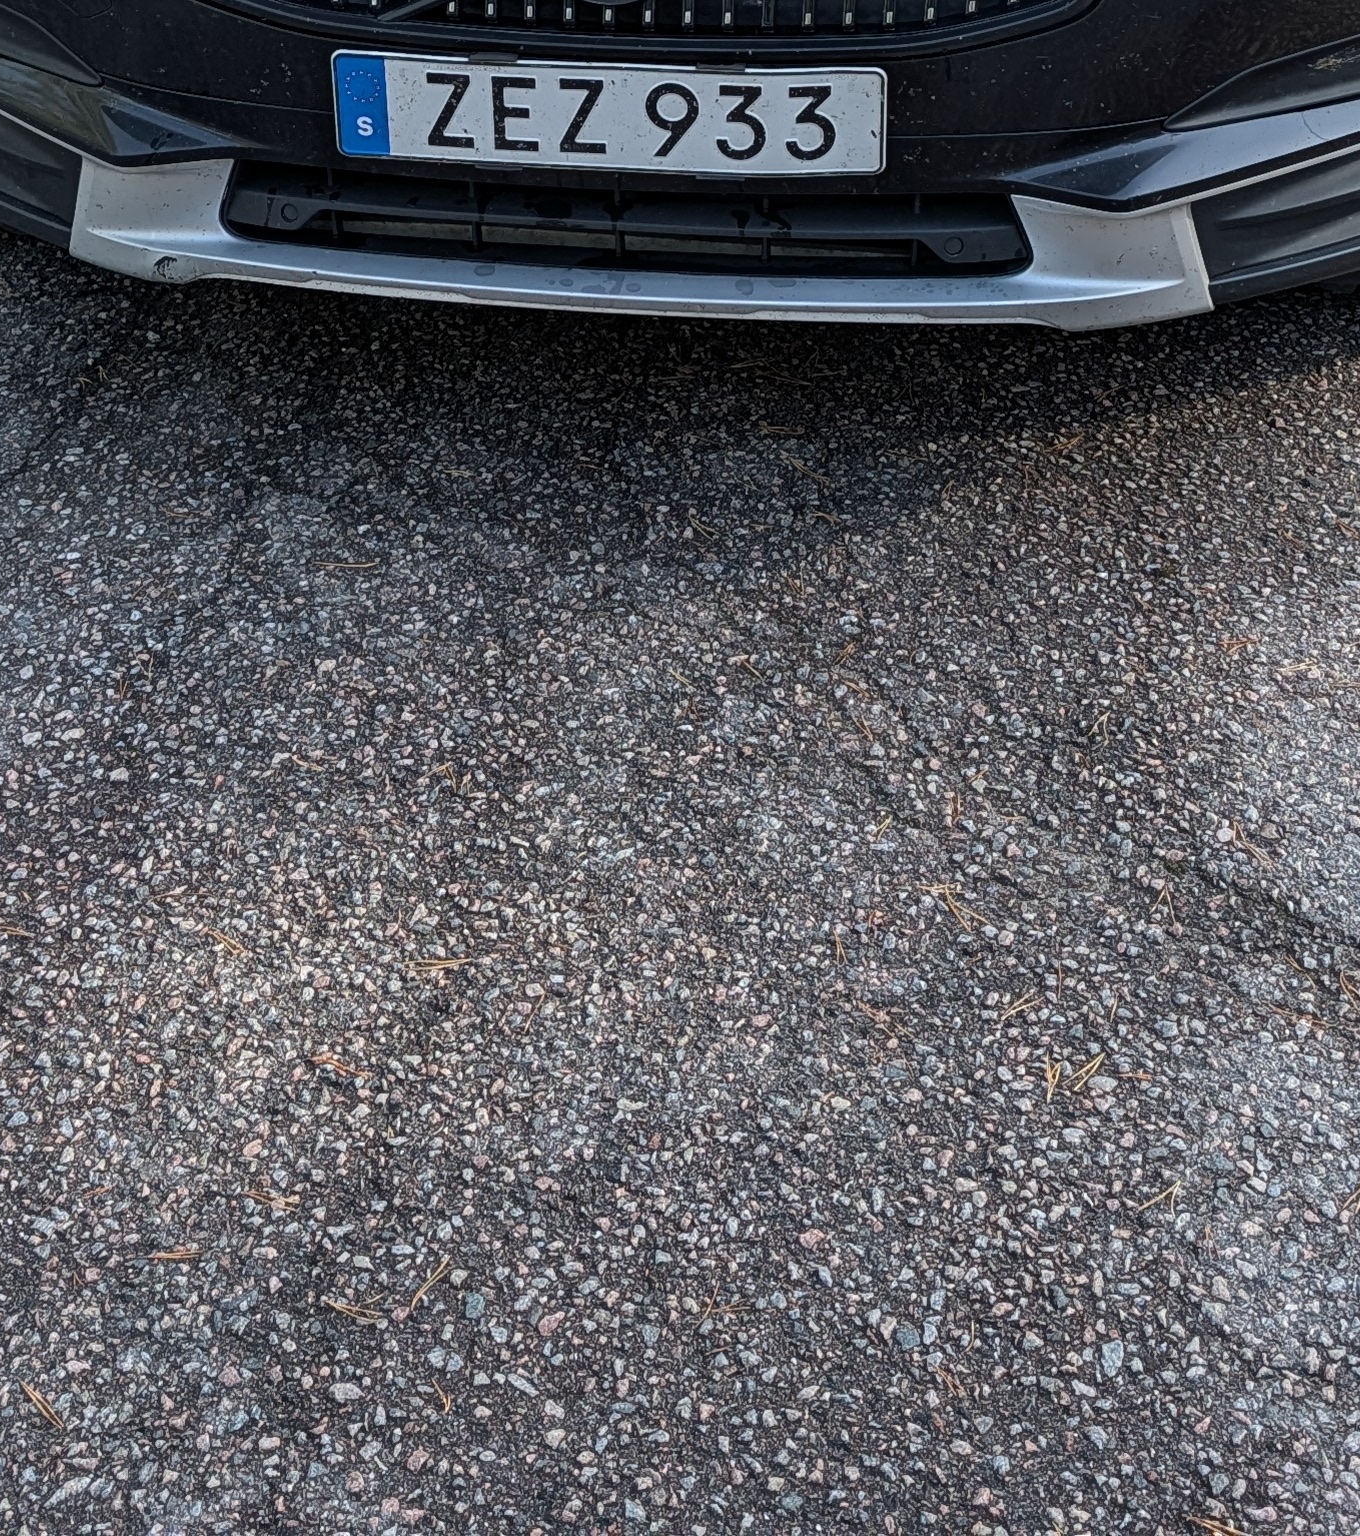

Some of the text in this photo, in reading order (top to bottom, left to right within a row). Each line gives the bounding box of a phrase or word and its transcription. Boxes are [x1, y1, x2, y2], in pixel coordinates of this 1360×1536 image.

[356, 116, 373, 137] S
[426, 71, 837, 161] ZEZ 933
